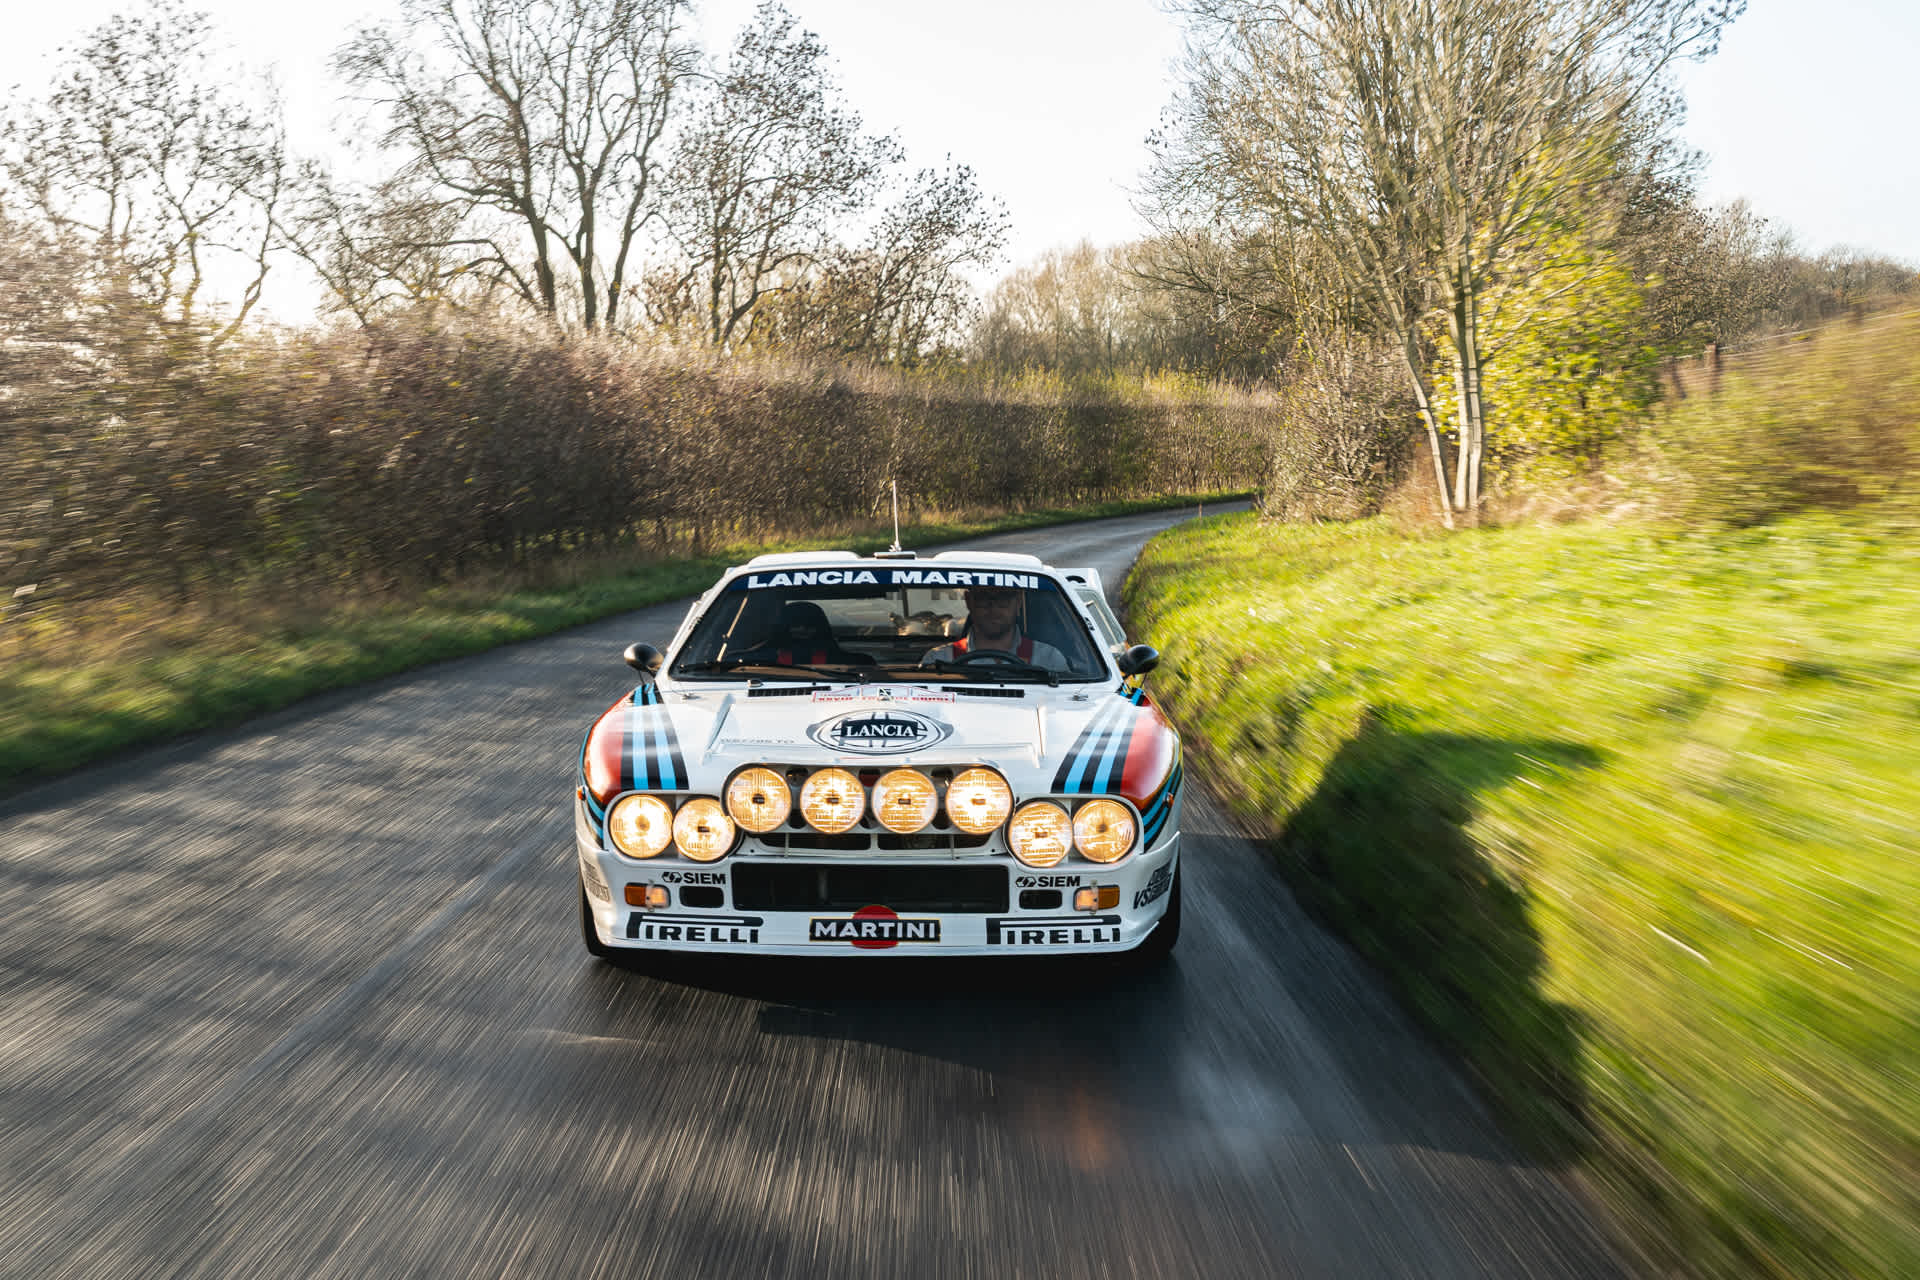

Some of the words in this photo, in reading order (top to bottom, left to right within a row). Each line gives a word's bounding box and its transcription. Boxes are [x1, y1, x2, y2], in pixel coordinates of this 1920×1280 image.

[748, 571, 878, 588] LANCIA
[892, 571, 1038, 589] MARTINI
[846, 724, 915, 738] LANCIA
[684, 872, 726, 885] SIEM
[1037, 876, 1081, 888] SIEM
[626, 911, 764, 944] PIRELLI
[815, 921, 936, 939] MARTINI
[985, 914, 1122, 945] PIRELLI
